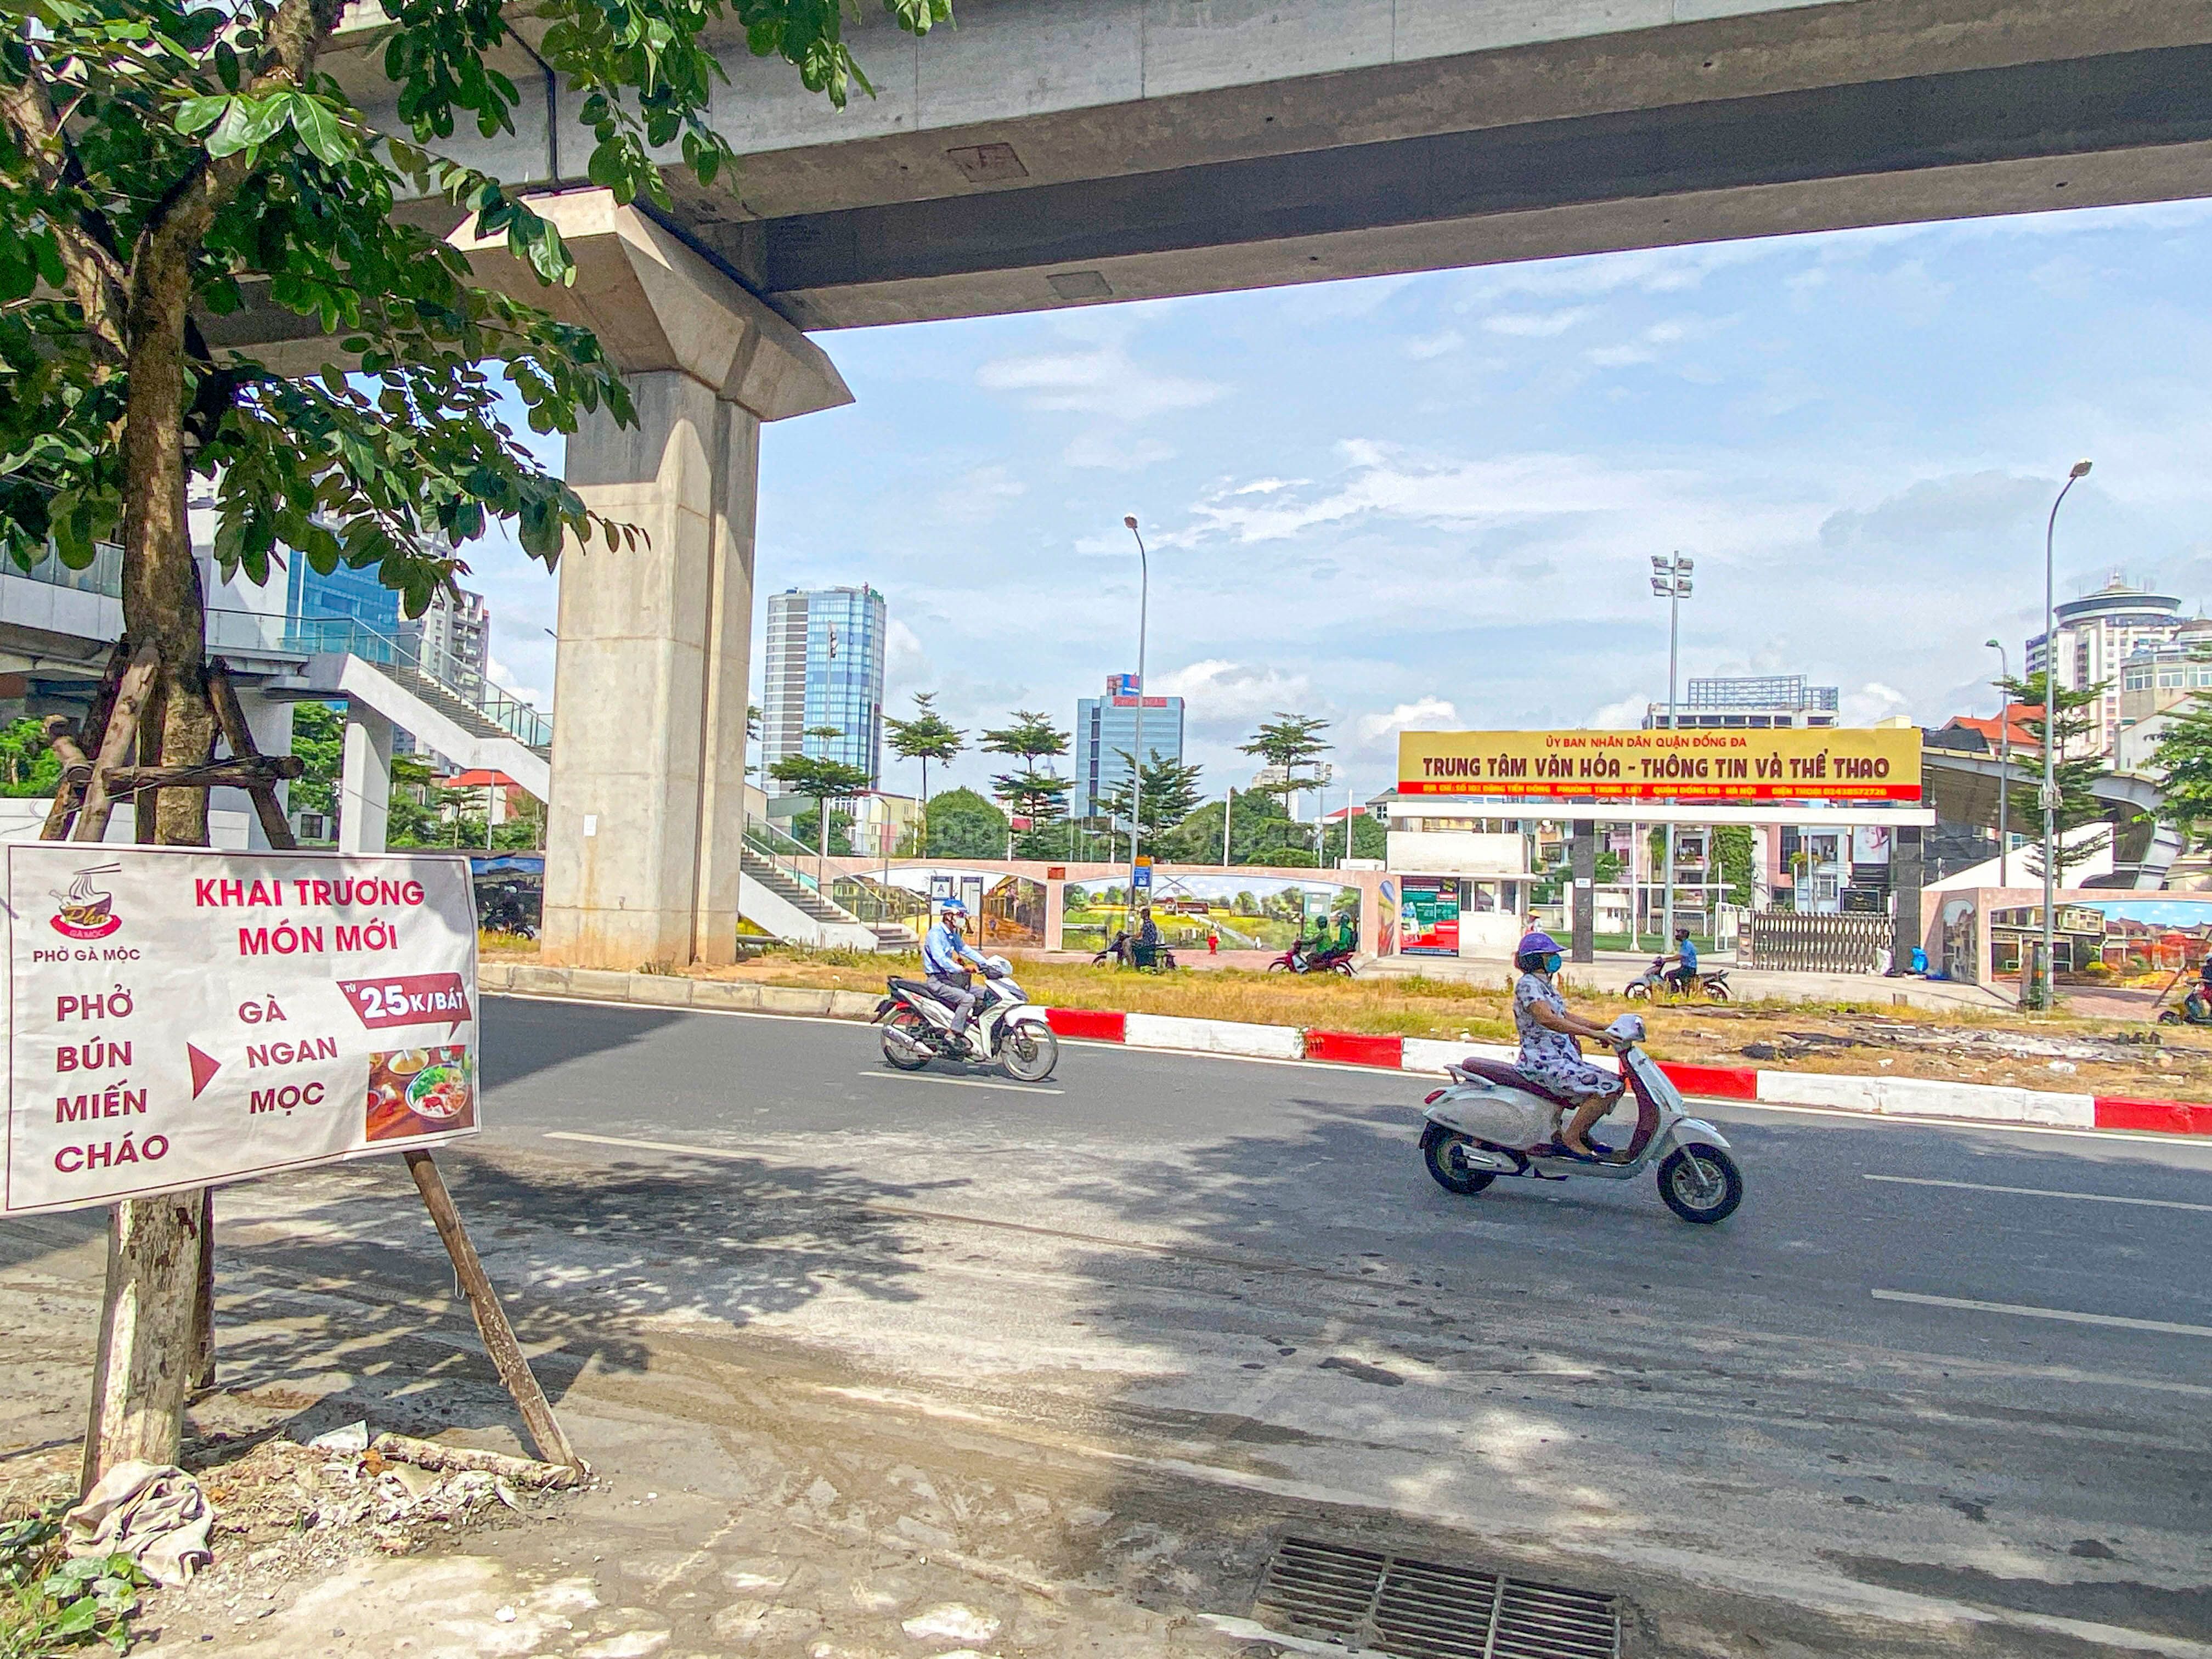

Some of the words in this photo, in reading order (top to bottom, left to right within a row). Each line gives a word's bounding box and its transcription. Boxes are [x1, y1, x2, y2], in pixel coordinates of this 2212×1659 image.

[1546, 735, 1560, 747] ỦY
[1564, 738, 1585, 747] BAN
[1591, 735, 1622, 747] NHÂN
[1627, 735, 1651, 747] DÂN
[1656, 736, 1689, 749] QUẬN
[1693, 732, 1726, 747] ĐỐNG
[1730, 737, 1747, 747] ĐA
[1423, 758, 1480, 777] TRUNG
[1487, 753, 1527, 777] TÂM
[1535, 754, 1573, 777] VĂN
[1581, 752, 1620, 777] HÓA
[1641, 754, 1708, 778] THÔNG
[1715, 758, 1747, 778] TIN
[1755, 752, 1782, 778] VÀ
[1790, 748, 1829, 778] THỂ
[1833, 758, 1890, 778] THAO
[195, 878, 281, 907] KHAI
[294, 877, 425, 906] TRƯƠNG
[937, 884, 945, 893] A
[239, 919, 324, 956] MÓN
[336, 915, 398, 952] MỚI
[33, 946, 69, 962] PHỞ
[75, 946, 99, 961] GÀ
[104, 946, 140, 964] MỘC
[57, 984, 133, 1022] PHỞ
[239, 995, 287, 1024] GÀ
[57, 1036, 132, 1071] BÚN
[246, 1037, 337, 1068] NGAN
[56, 1079, 147, 1122] MIẾN
[250, 1082, 325, 1114] MỌC
[55, 1133, 169, 1172] CHÁO
